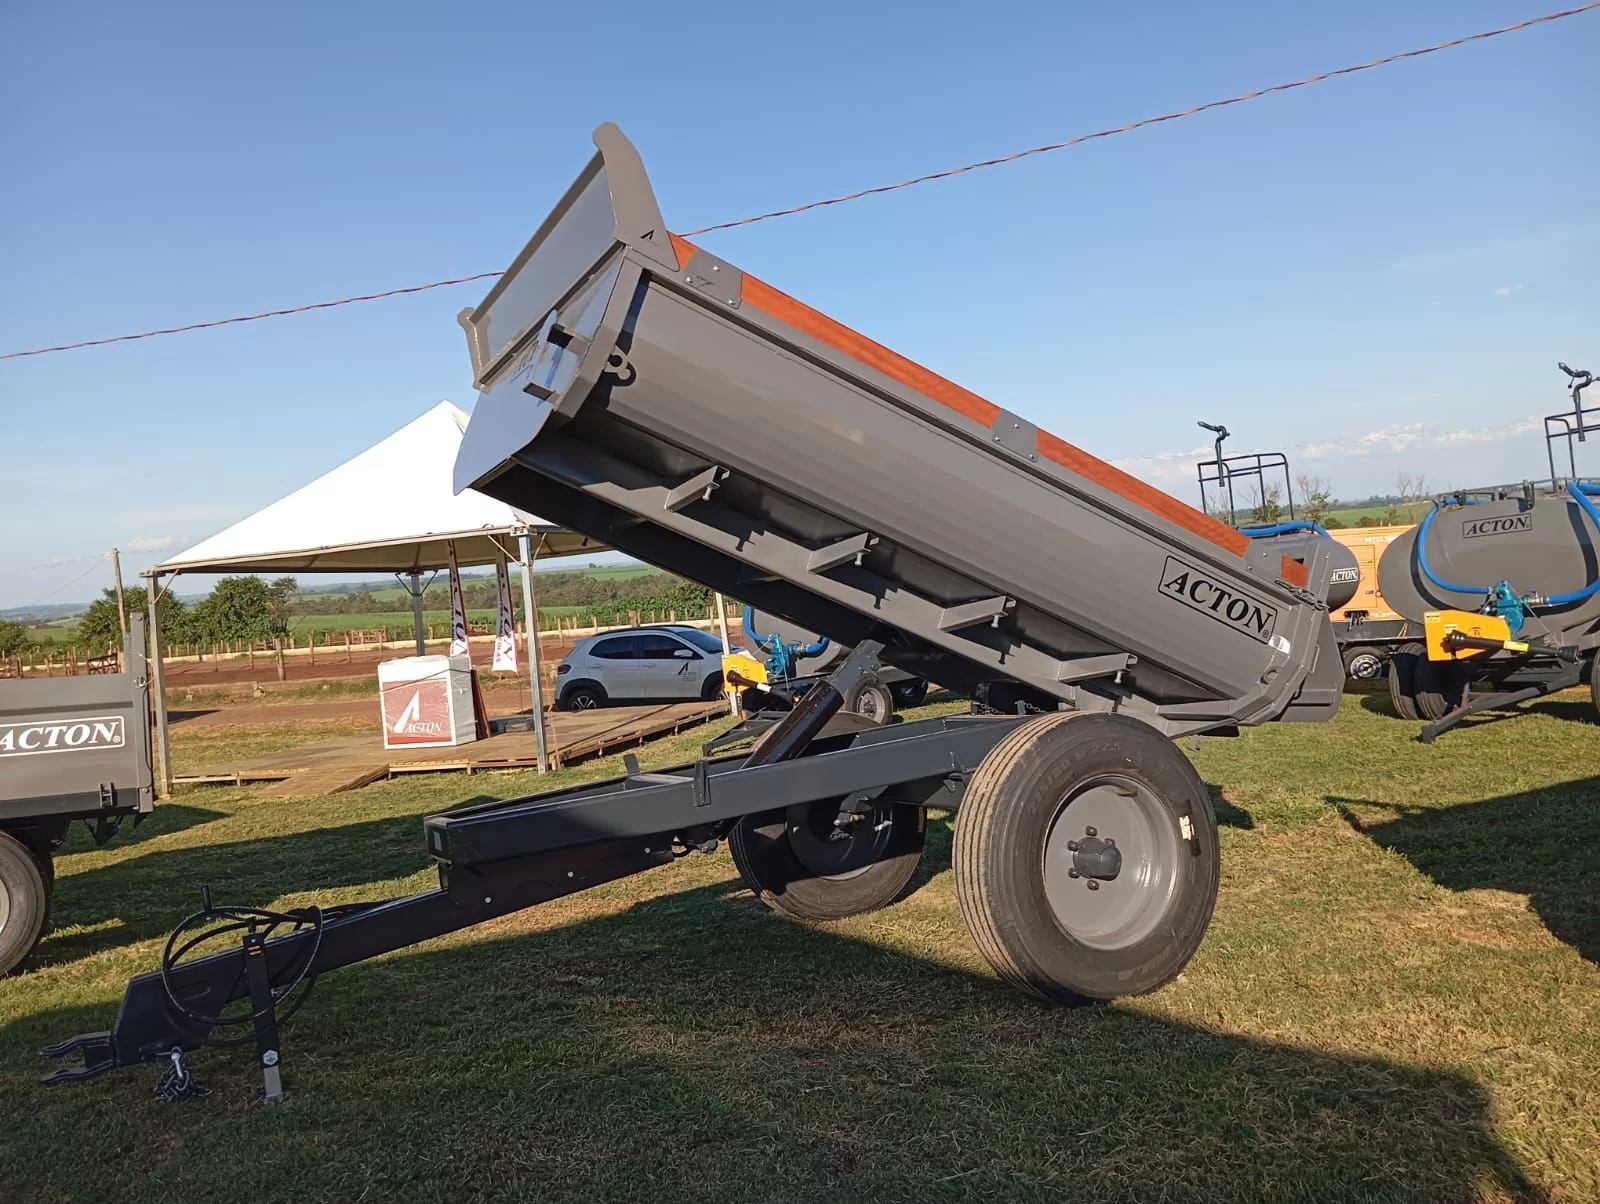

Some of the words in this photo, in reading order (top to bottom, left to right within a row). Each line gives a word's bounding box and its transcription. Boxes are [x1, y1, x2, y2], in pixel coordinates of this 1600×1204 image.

[1466, 516, 1529, 536] ACTON
[1330, 570, 1357, 582] ACTON
[1163, 571, 1274, 634] ACTON
[0, 722, 119, 751] ACTON
[404, 721, 442, 734] ACTON
